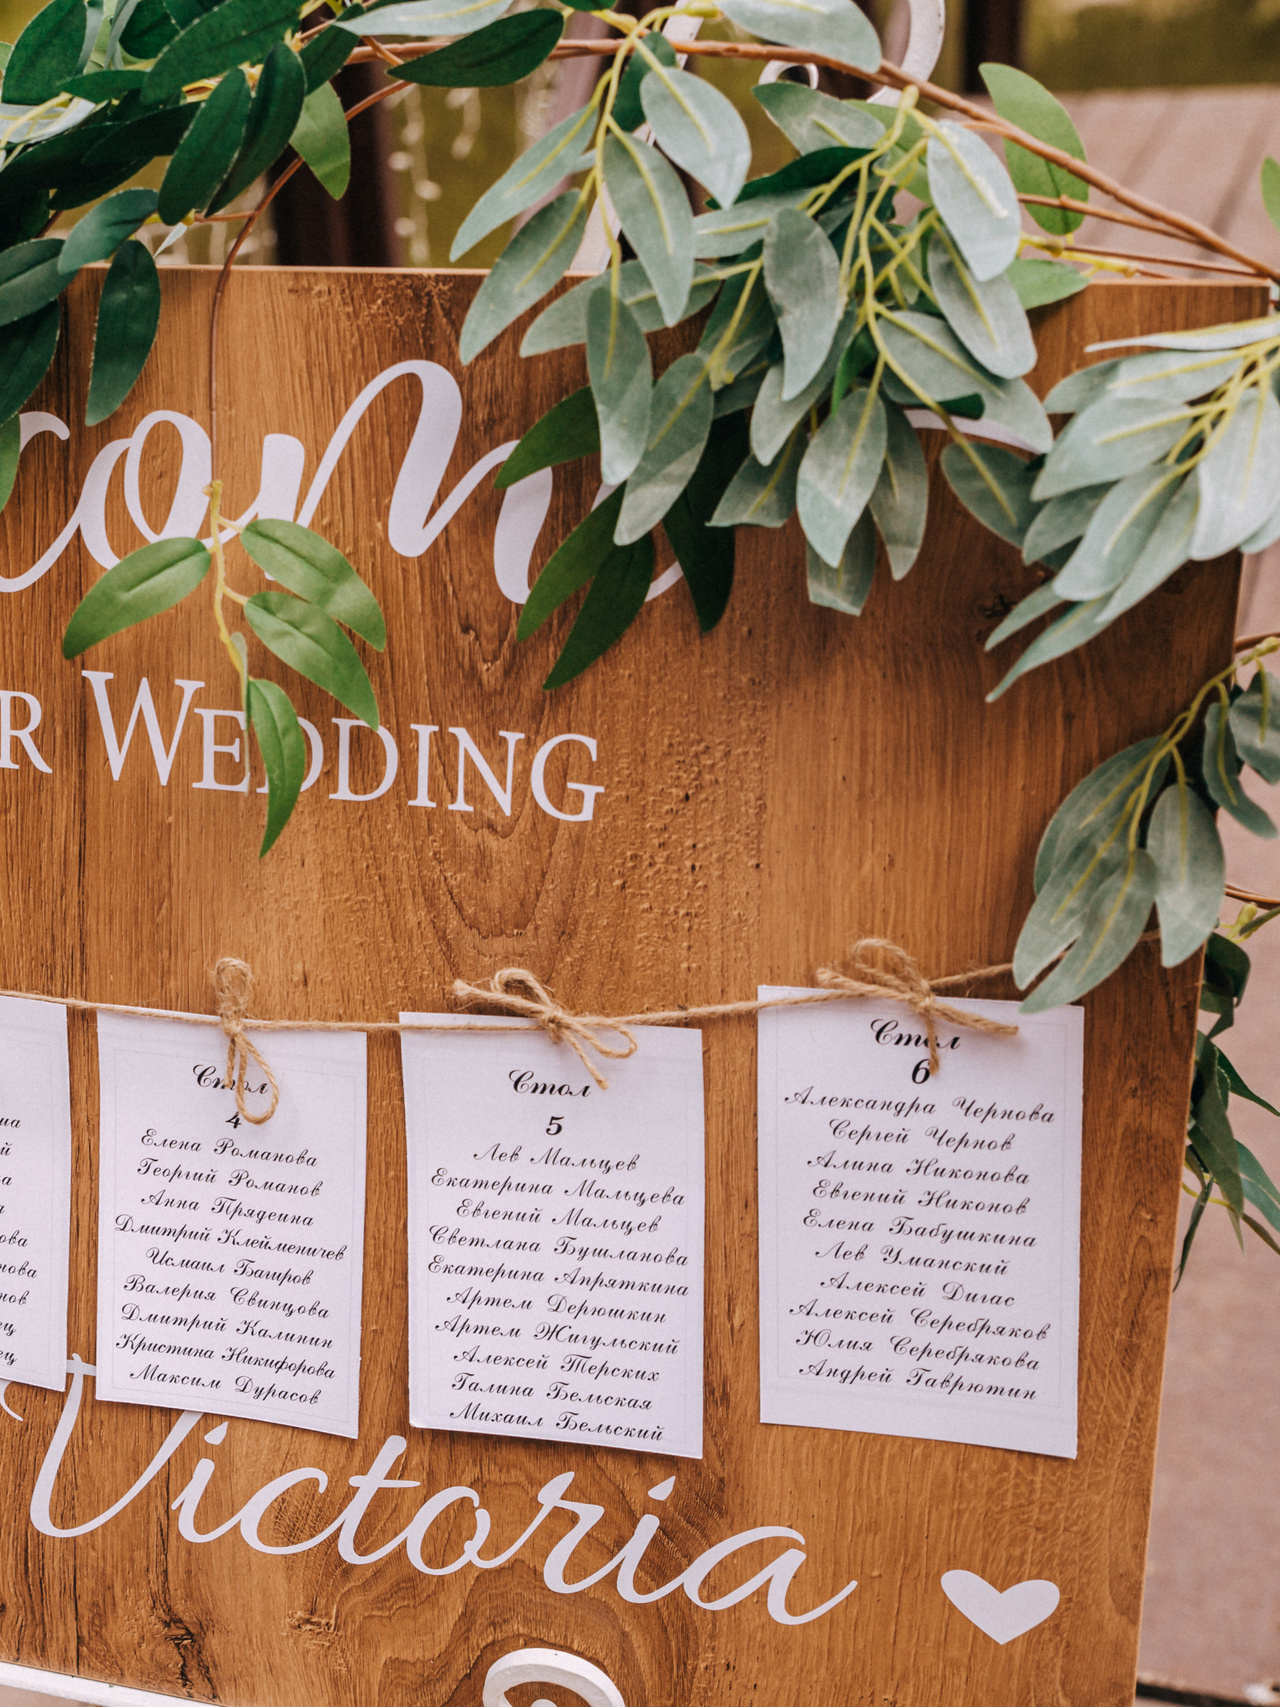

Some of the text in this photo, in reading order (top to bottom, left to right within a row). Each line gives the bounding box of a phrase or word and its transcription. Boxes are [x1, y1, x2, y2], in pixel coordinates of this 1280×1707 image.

[508, 1069, 591, 1098] Стол
[911, 1058, 931, 1085] 6
[225, 1111, 242, 1129] 4
[784, 1085, 1055, 1124] Александра Чернова
[545, 1115, 565, 1136] 5
[829, 1118, 1016, 1153] Сергей Чернов
[141, 1128, 318, 1167] Елена Романова
[473, 1143, 640, 1175] Лев Мальцев
[137, 1157, 324, 1197] Георгий Романов
[807, 1149, 1030, 1185] Алина Никонова
[140, 1189, 200, 1211] Анна
[431, 1167, 685, 1207] Екатерина Мальцева
[812, 1179, 1031, 1215] Евгений Никонов
[114, 1214, 213, 1243] Дмитрий
[456, 1198, 662, 1236] Евгений Мальцев
[803, 1208, 1036, 1247] Елена Бабушкина
[429, 1225, 541, 1253] Светлана
[815, 1241, 1010, 1275] Лев Уманский
[145, 1247, 314, 1287] Исмаил Багиров
[427, 1254, 545, 1283] Екатерина
[820, 1271, 928, 1297] Алексей
[123, 1274, 329, 1319] Валерия Свинцова
[446, 1286, 666, 1324] Артем Дерюшкин
[121, 1302, 333, 1349] Дмитрий Калинин
[434, 1314, 680, 1355] Артем Жигульский
[789, 1298, 1051, 1341] Алексей Серебряков
[115, 1333, 335, 1379] Кристина Никифорова
[453, 1345, 660, 1382] Алексей Терских
[795, 1329, 1039, 1370] Юлия Серебрякова
[129, 1363, 322, 1405] Максим Дурасов
[798, 1358, 894, 1385] Андрей
[451, 1372, 652, 1410] Галина Бельская
[449, 1401, 665, 1442] Михаил Бельский
